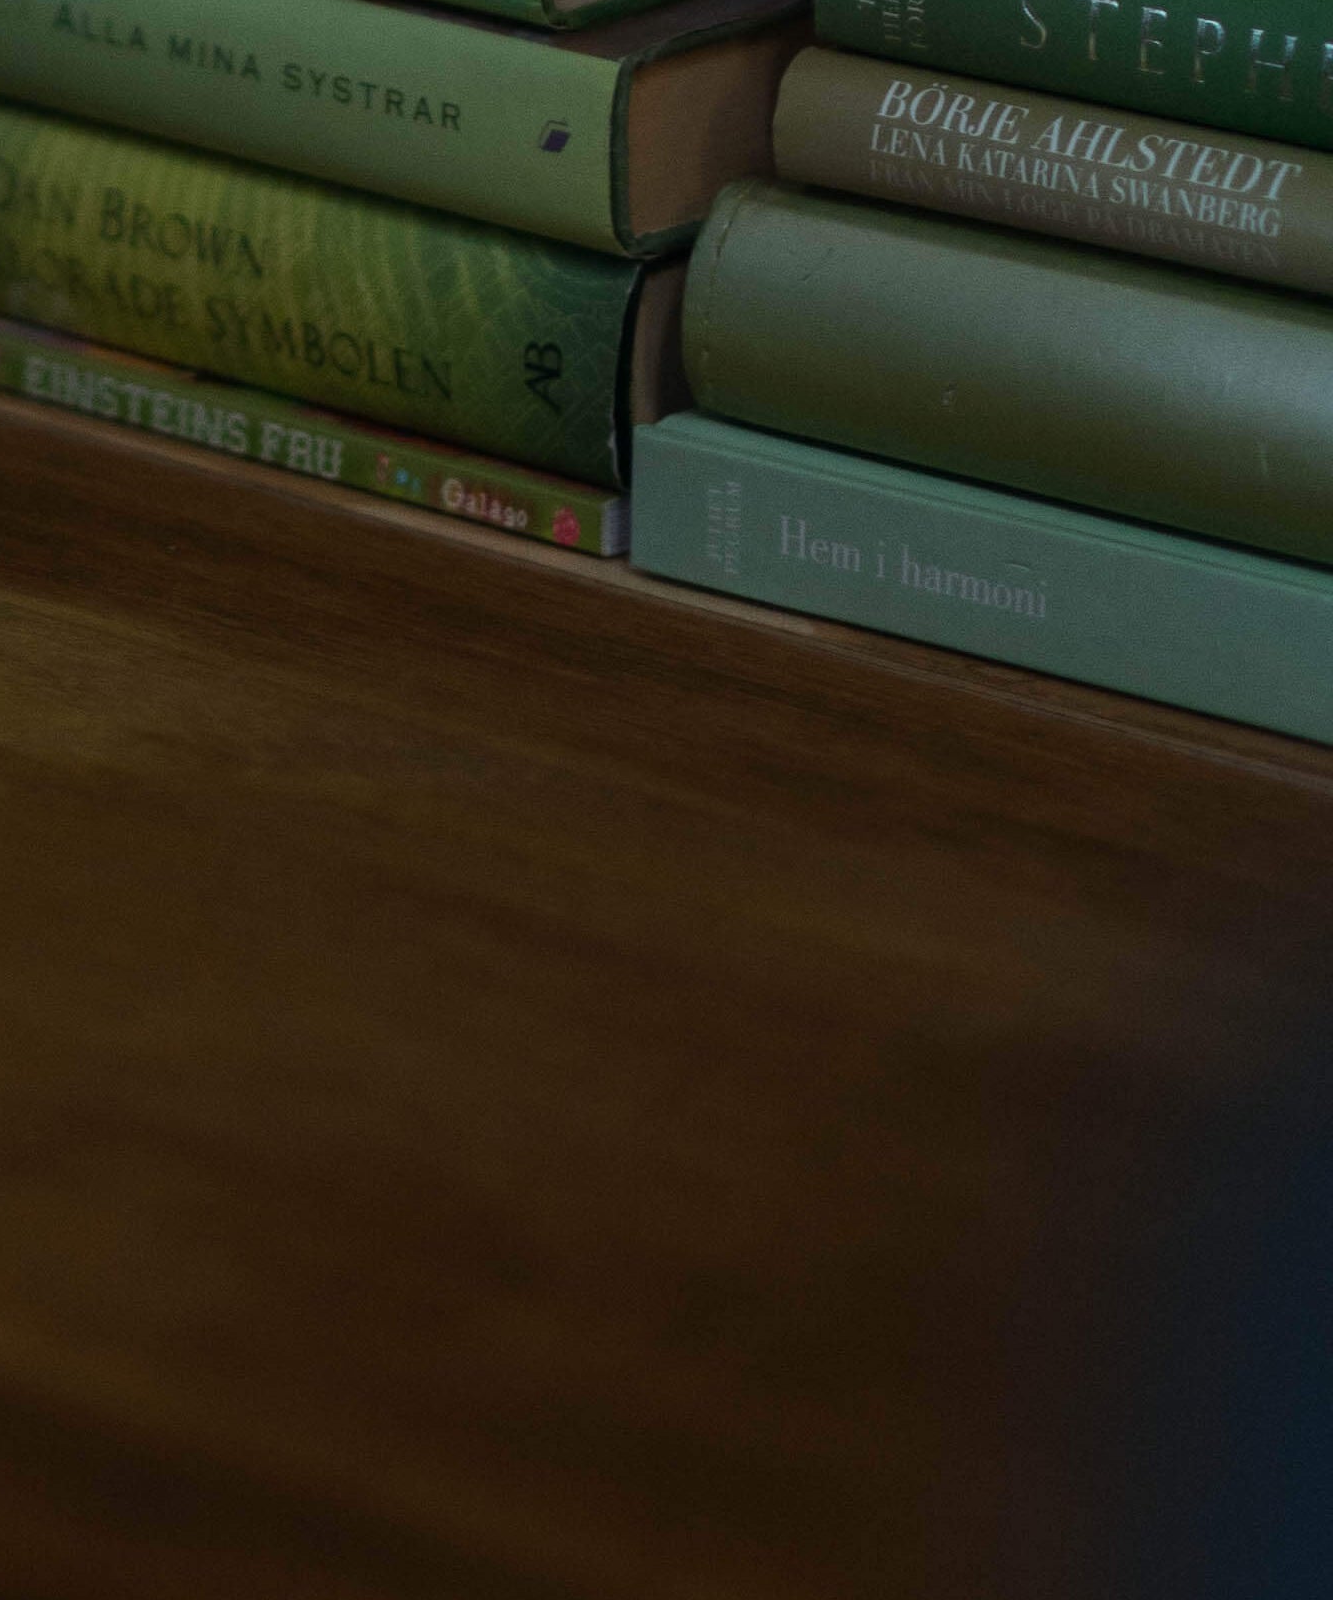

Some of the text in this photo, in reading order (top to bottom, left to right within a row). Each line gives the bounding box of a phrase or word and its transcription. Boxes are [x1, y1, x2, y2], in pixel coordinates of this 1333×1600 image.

[49, 0, 465, 134] ALLA MINA SYSTRAR
[869, 122, 1282, 239] LENA KATARINA SWANBERG
[875, 78, 1304, 202] BÖRJE AHLSTEDT
[99, 185, 265, 280] BROWN
[205, 296, 453, 402] SYMBOLEN
[23, 354, 345, 482] EINSTEINS FRU
[440, 475, 531, 531] Galago
[780, 513, 862, 574] Hem
[874, 540, 887, 580] i
[898, 542, 1048, 620] harmoni
